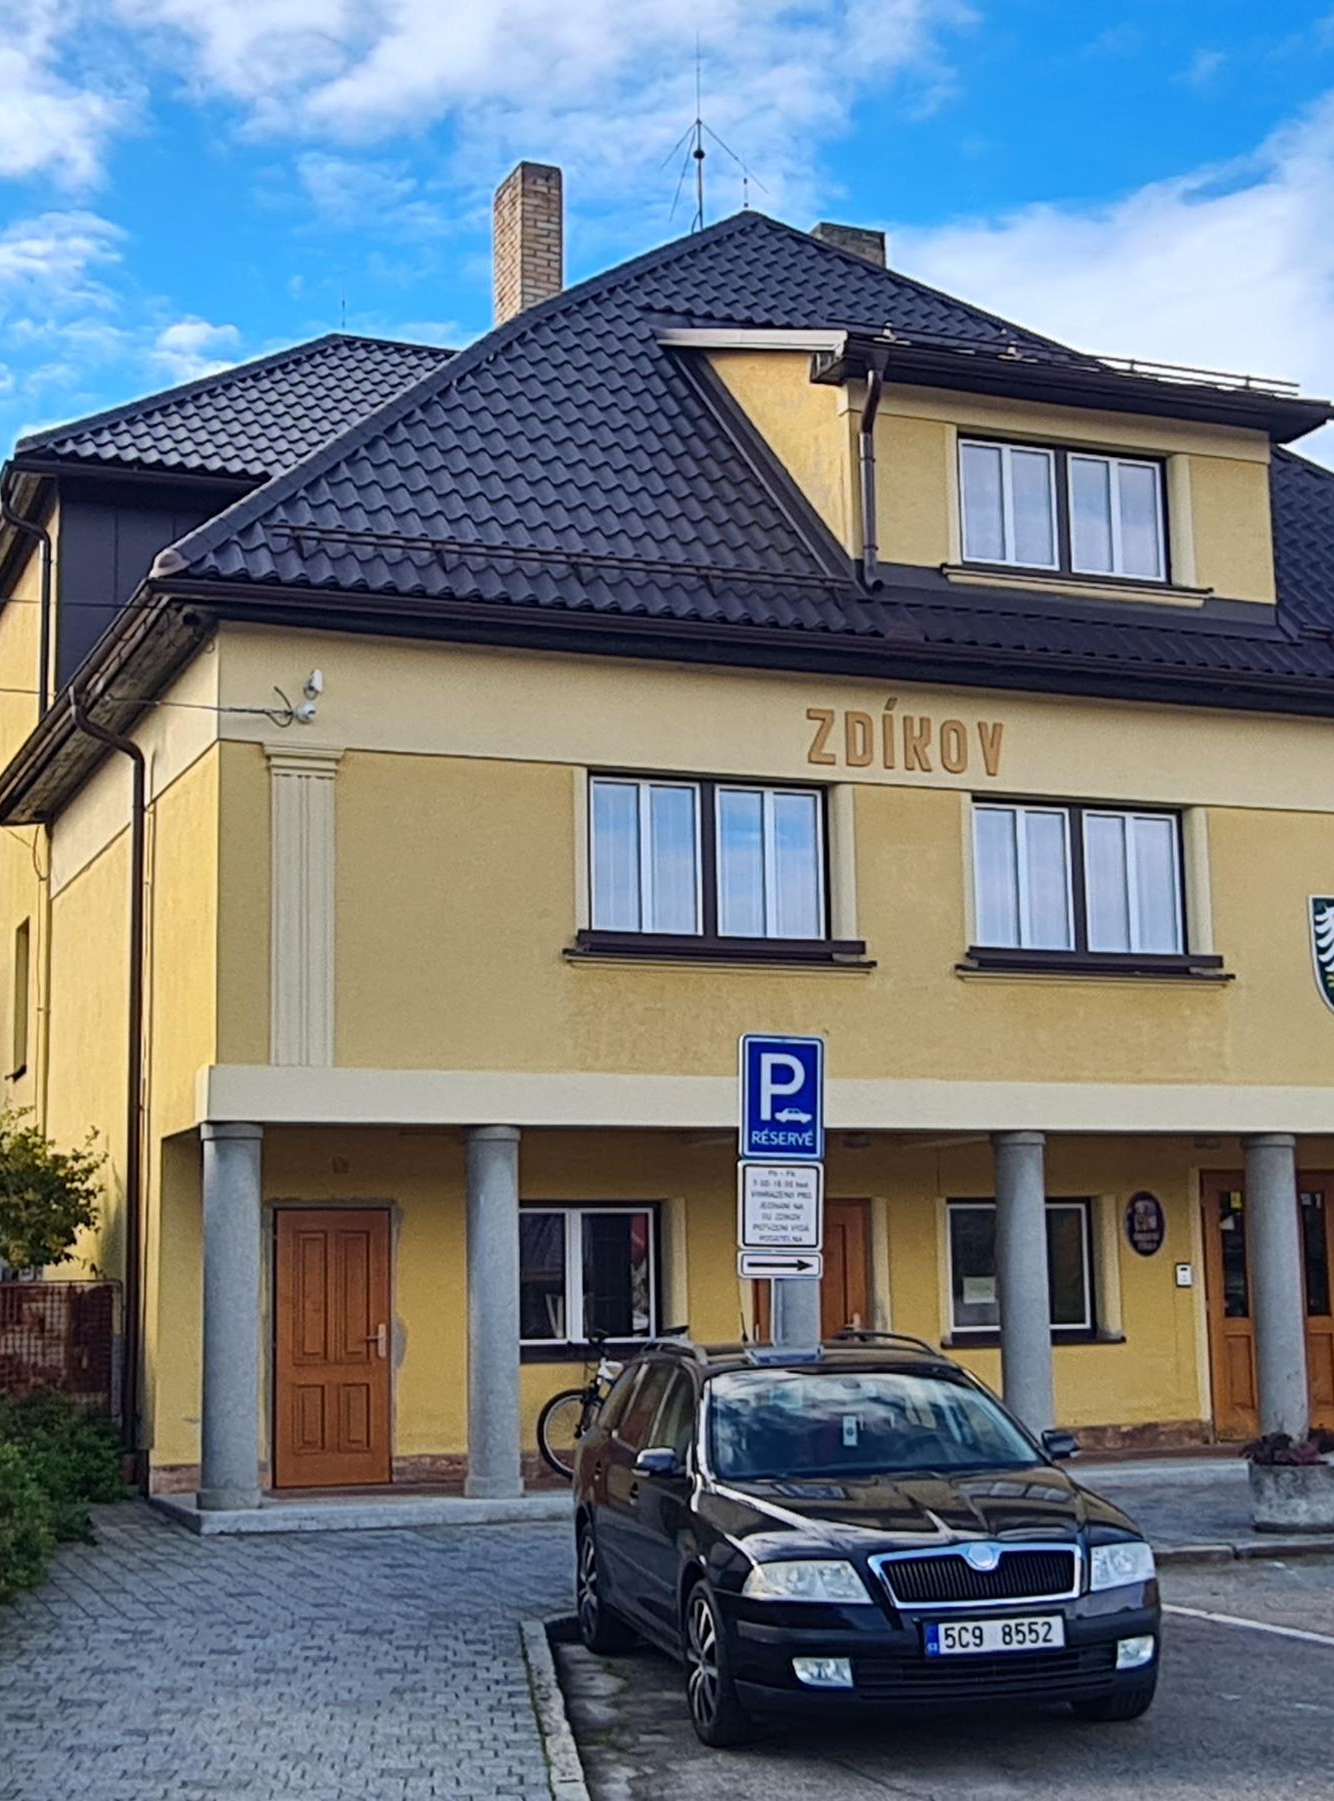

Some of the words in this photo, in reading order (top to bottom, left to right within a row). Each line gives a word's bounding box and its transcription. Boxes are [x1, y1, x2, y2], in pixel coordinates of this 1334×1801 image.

[805, 696, 1004, 777] ZDÍKOV
[760, 1052, 806, 1121] P
[751, 1129, 814, 1147] RÉSERVÉ
[944, 1626, 984, 1649] 5C9
[1001, 1620, 1054, 1646] 8552
